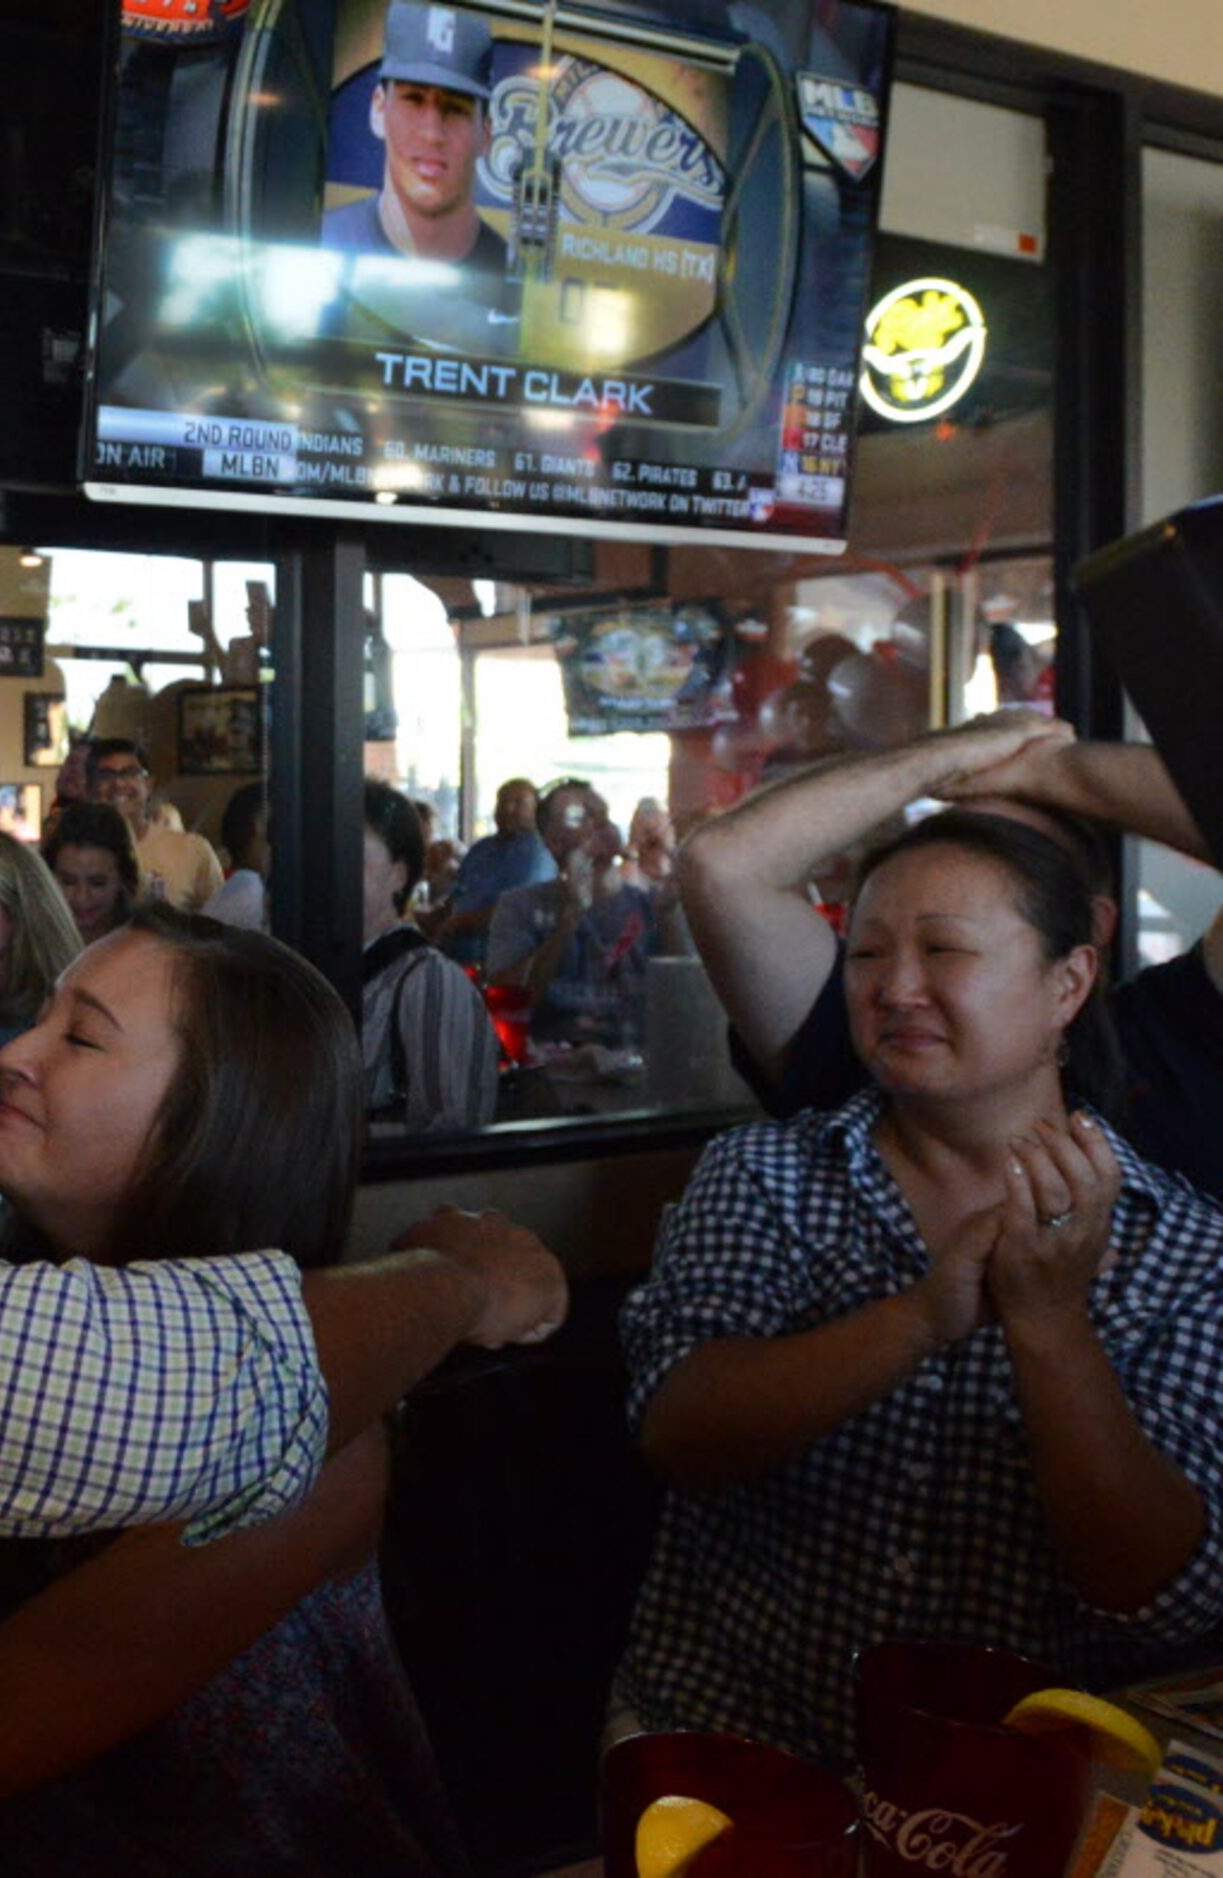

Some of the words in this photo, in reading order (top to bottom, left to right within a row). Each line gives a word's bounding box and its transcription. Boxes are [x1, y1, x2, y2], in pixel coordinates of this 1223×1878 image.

[478, 74, 724, 198] Brewers
[376, 353, 516, 396] TRENT
[525, 372, 654, 414] CLARK
[184, 422, 222, 446] 2ND
[228, 426, 292, 450] ROUND
[126, 447, 165, 469] AIR
[221, 454, 280, 477] MLBN
[414, 442, 495, 469] MARINERS
[638, 463, 698, 488] PIRATES
[448, 474, 460, 494] &
[464, 475, 526, 498] FOLLOW
[529, 482, 550, 500] US
[669, 493, 689, 513] ON
